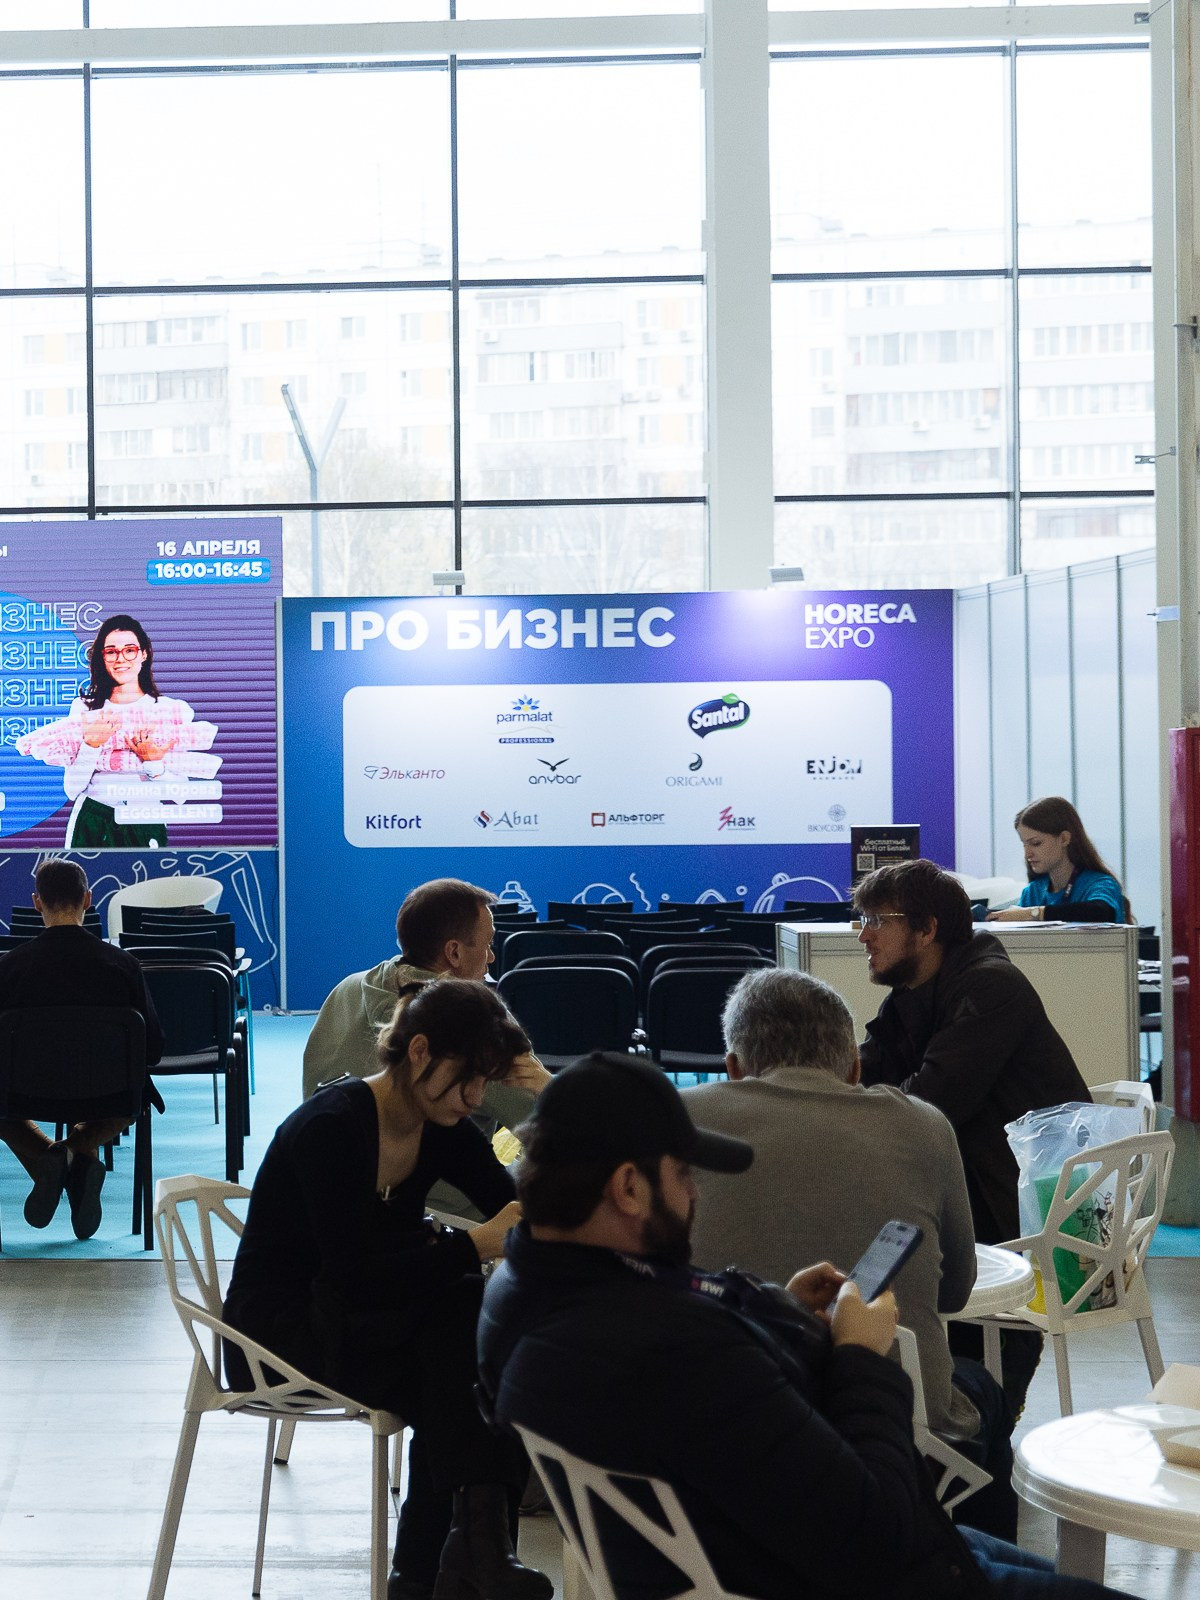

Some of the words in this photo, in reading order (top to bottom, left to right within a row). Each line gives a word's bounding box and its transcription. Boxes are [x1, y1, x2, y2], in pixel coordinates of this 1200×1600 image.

[156, 541, 177, 556] 16
[181, 539, 261, 556] АПРЕЛЯ
[155, 561, 263, 578] 16:00-16:45
[804, 603, 917, 624] HORECA
[310, 609, 429, 651] ПРО
[446, 606, 676, 651] БИЗНЕС
[805, 626, 875, 649] EXPO
[496, 711, 553, 724] parmalat
[691, 700, 746, 730] Santal
[379, 766, 445, 780] Эльканто
[529, 774, 582, 784] anybar
[665, 776, 723, 787] ORIGAMI
[107, 784, 161, 797] Полина
[166, 783, 217, 796] Юрова
[120, 807, 218, 820] EGGSELLENT
[493, 810, 539, 829] Abat
[608, 813, 665, 822] АЛЬФТОРГ
[365, 815, 422, 829] Kitfort
